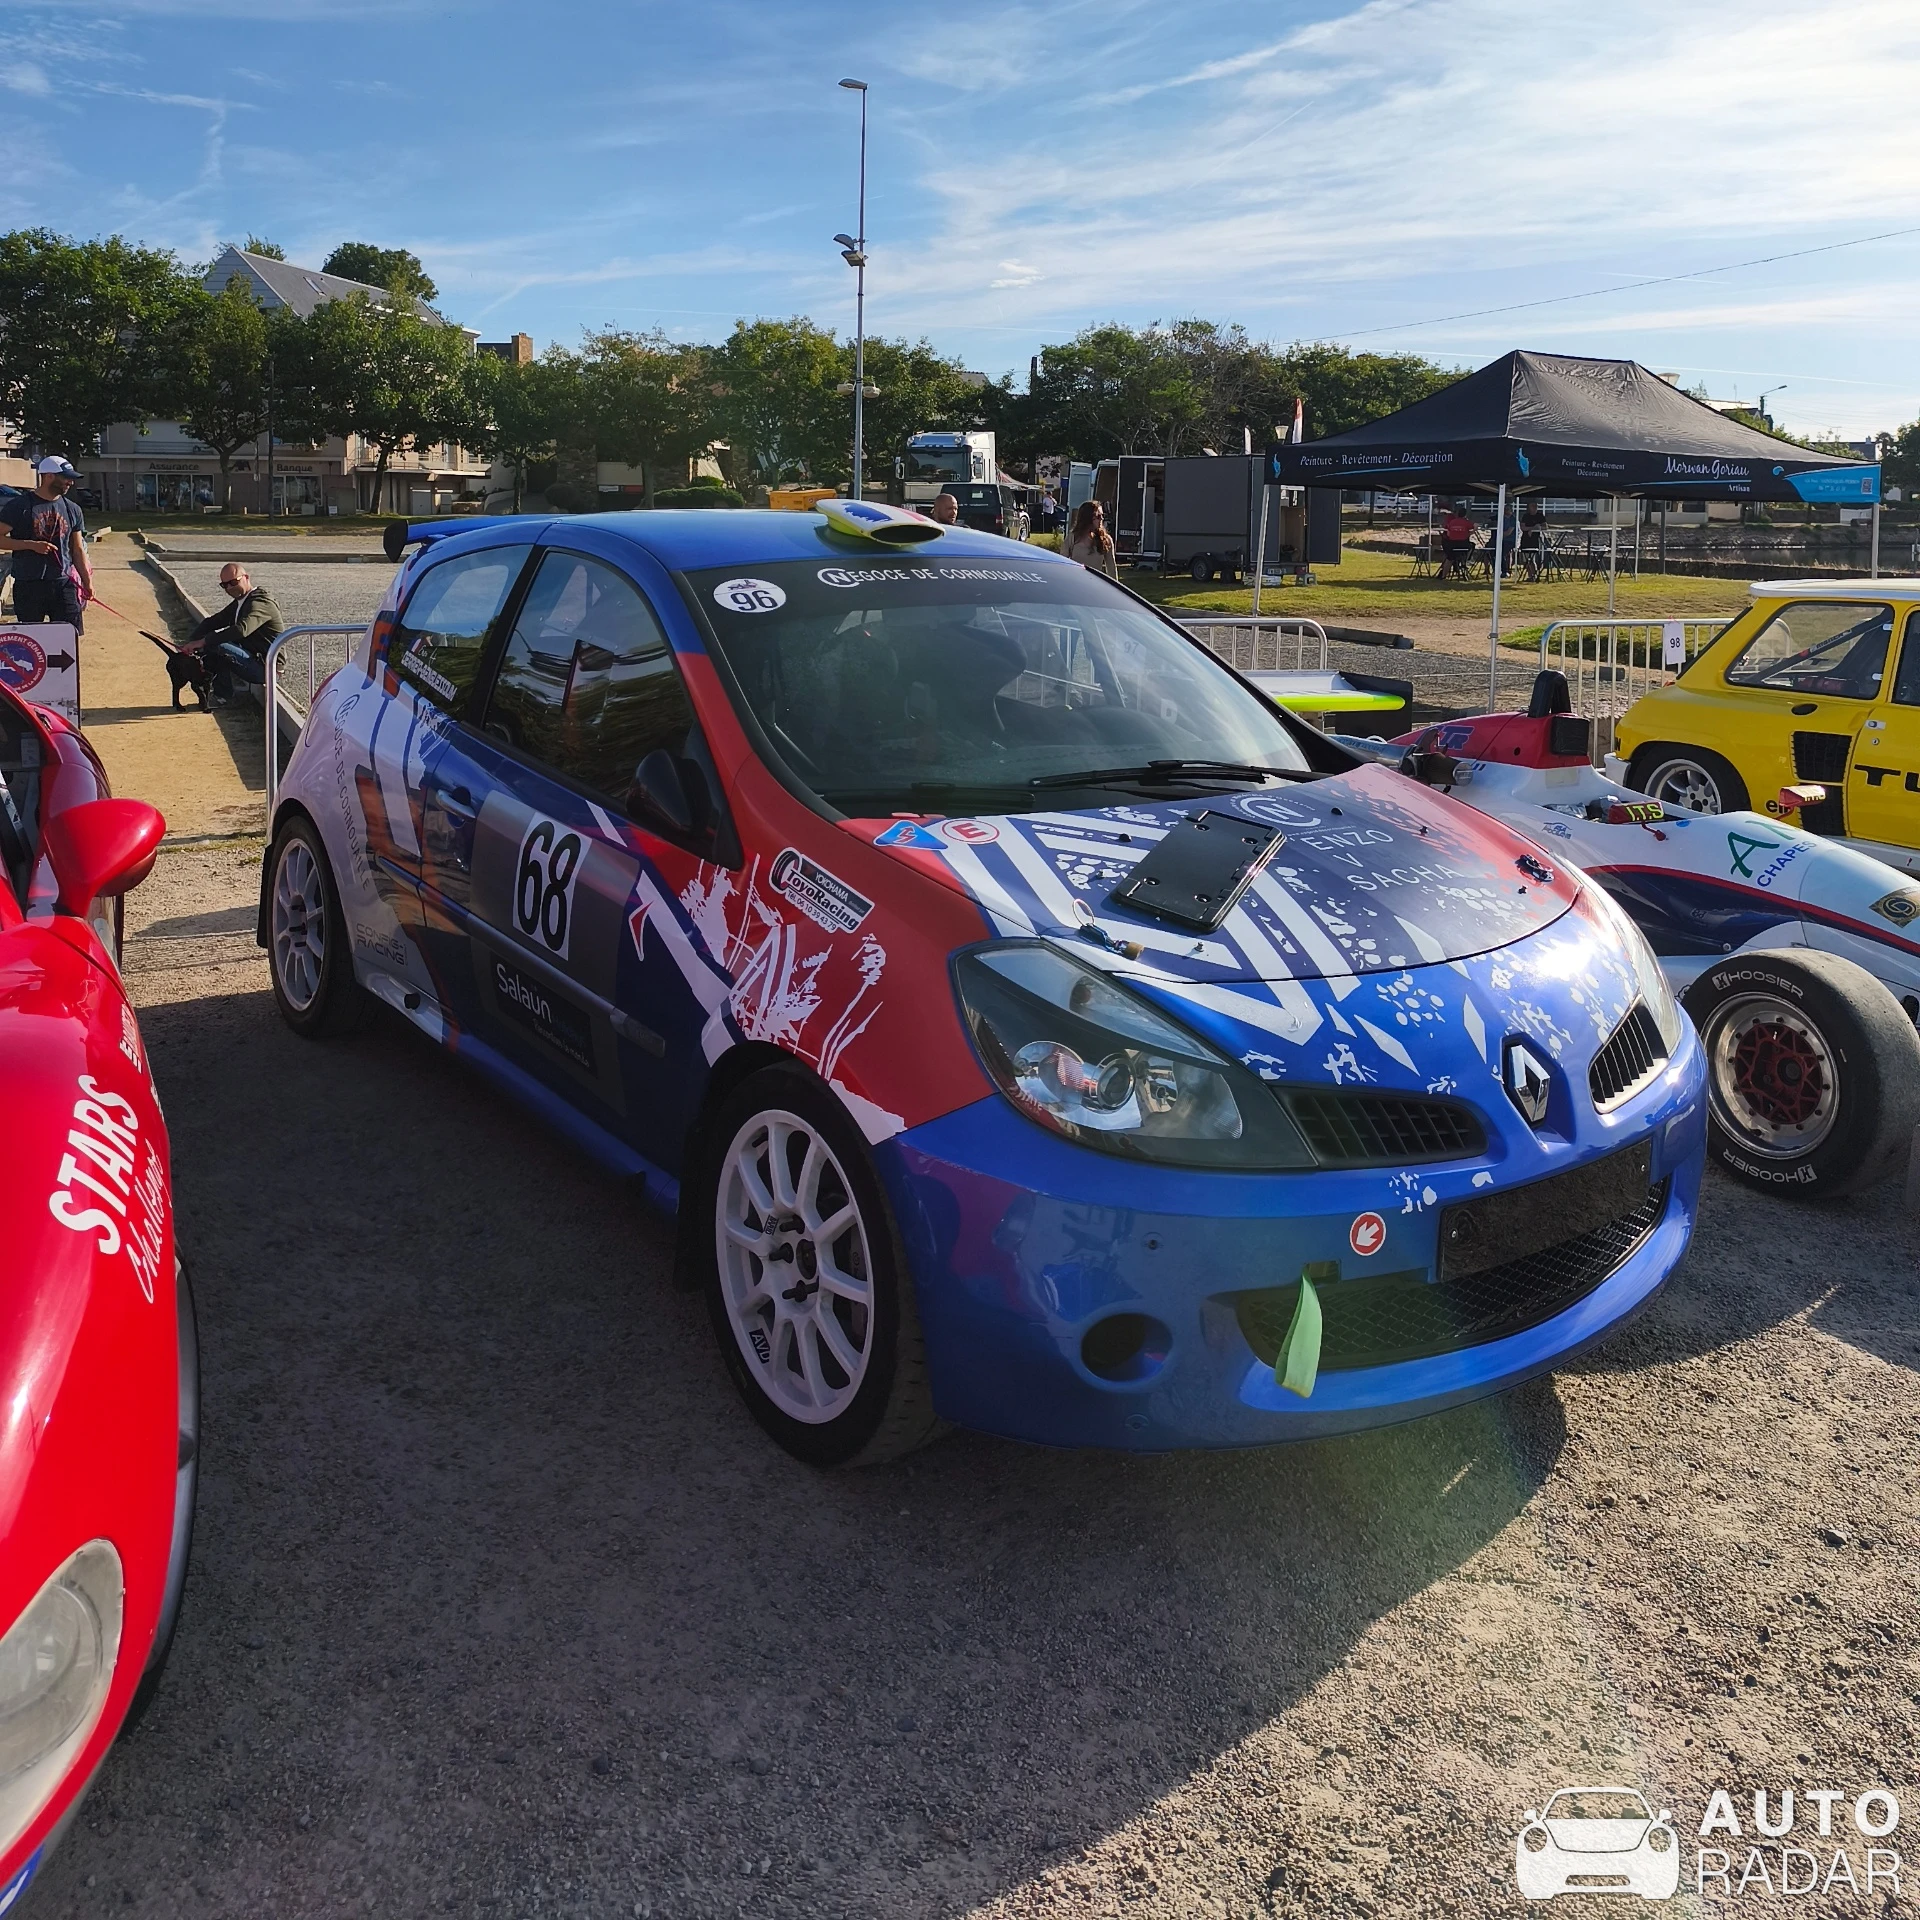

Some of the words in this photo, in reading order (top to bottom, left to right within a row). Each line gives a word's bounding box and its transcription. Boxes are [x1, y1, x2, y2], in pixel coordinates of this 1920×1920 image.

[149, 462, 200, 471] Assurance
[276, 463, 313, 474] Banque
[1300, 455, 1333, 466] Peinture
[1342, 453, 1392, 466] Revêtement
[1401, 451, 1453, 463] Décoration
[1727, 484, 1751, 493] Artisan
[913, 568, 939, 581] DE
[940, 568, 1048, 584] CORNOUAILLE
[731, 590, 778, 612] 96
[1669, 637, 1681, 649] 98
[335, 762, 344, 782] DE
[339, 783, 370, 891] CORNOUAILLE
[952, 822, 988, 841] E
[1301, 829, 1394, 851] ENZO
[517, 820, 581, 952] 68
[815, 871, 849, 902] YOKOHAMA
[1347, 864, 1464, 891] SACHA
[786, 870, 860, 931] ToyoRacing
[357, 934, 405, 966] RACING
[1729, 971, 1804, 999] HOOSIER
[49, 1074, 139, 1255] STARS
[1722, 1148, 1798, 1184] HOOSIER
